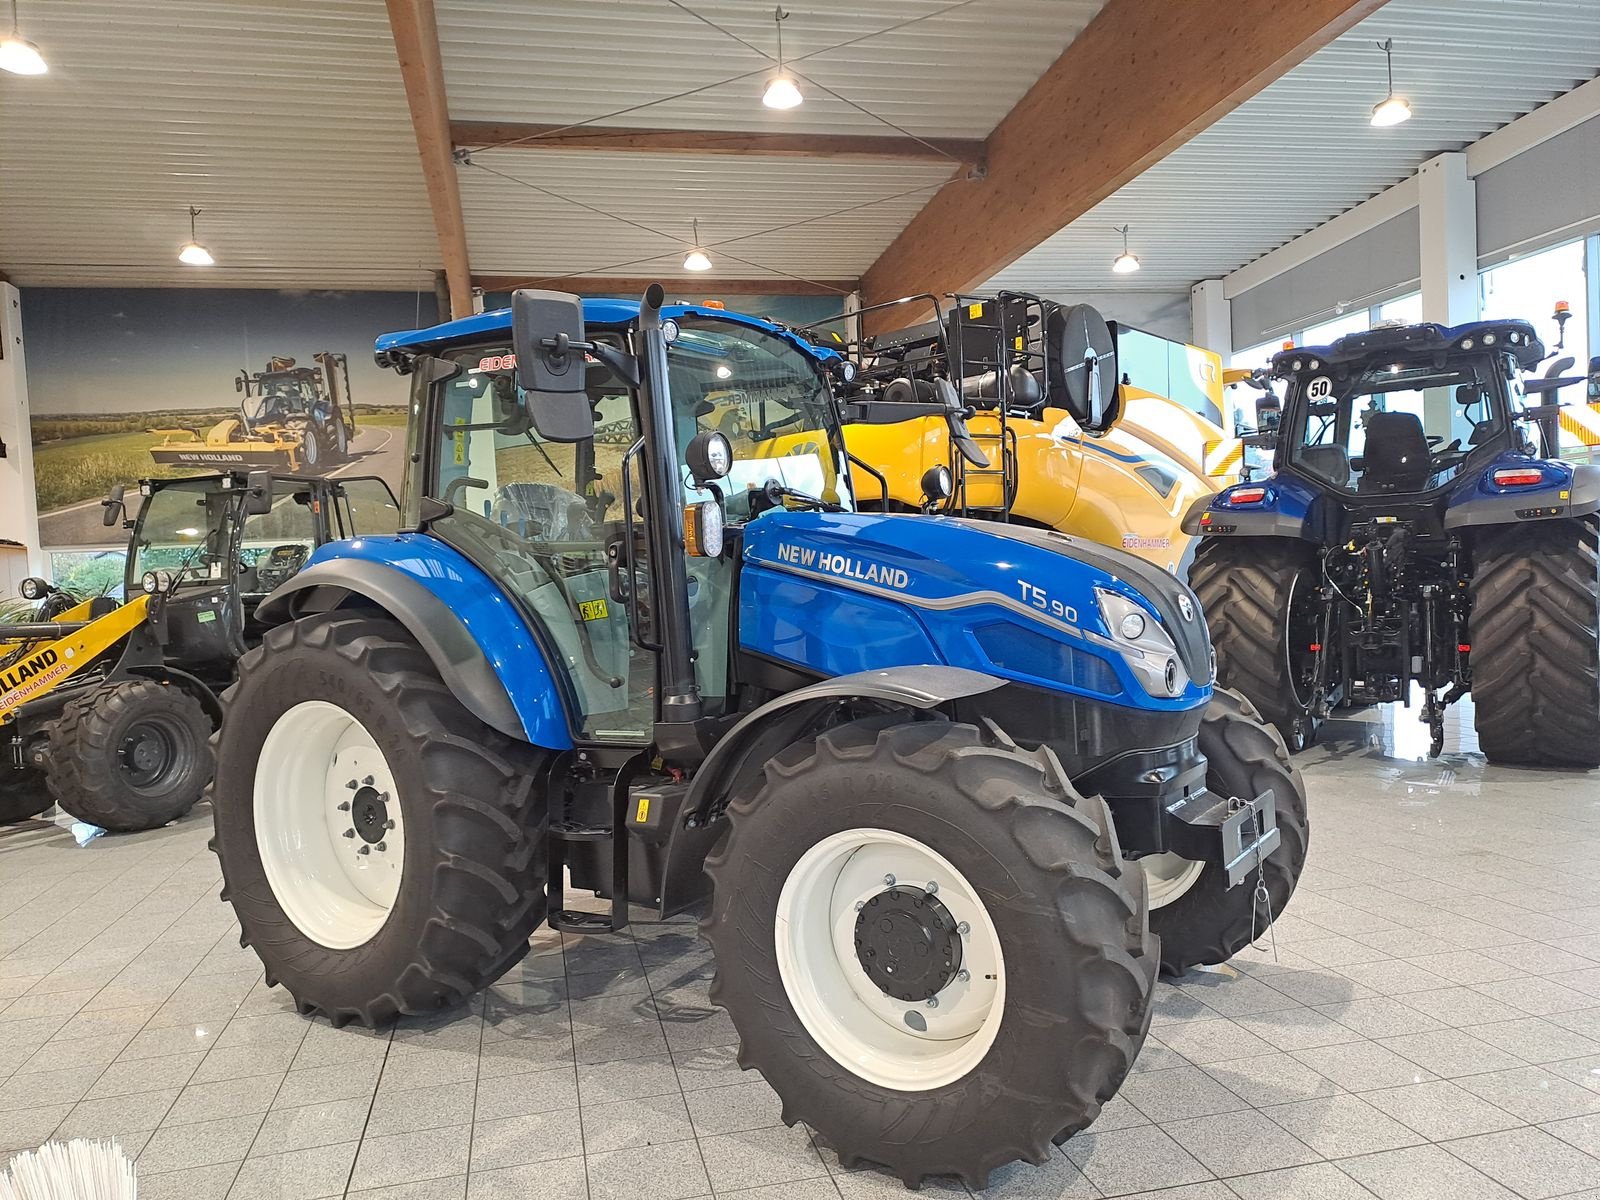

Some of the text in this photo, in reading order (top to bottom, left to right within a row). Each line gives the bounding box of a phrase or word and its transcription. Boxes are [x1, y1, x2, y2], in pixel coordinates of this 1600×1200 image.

[1311, 380, 1328, 397] 50
[179, 453, 243, 462] NEW HOLLAND
[1122, 537, 1170, 549] EIDENHAMMER
[777, 542, 908, 589] NEW HOLLAND
[1017, 579, 1078, 623] T5.90
[0, 649, 58, 697] LLAND
